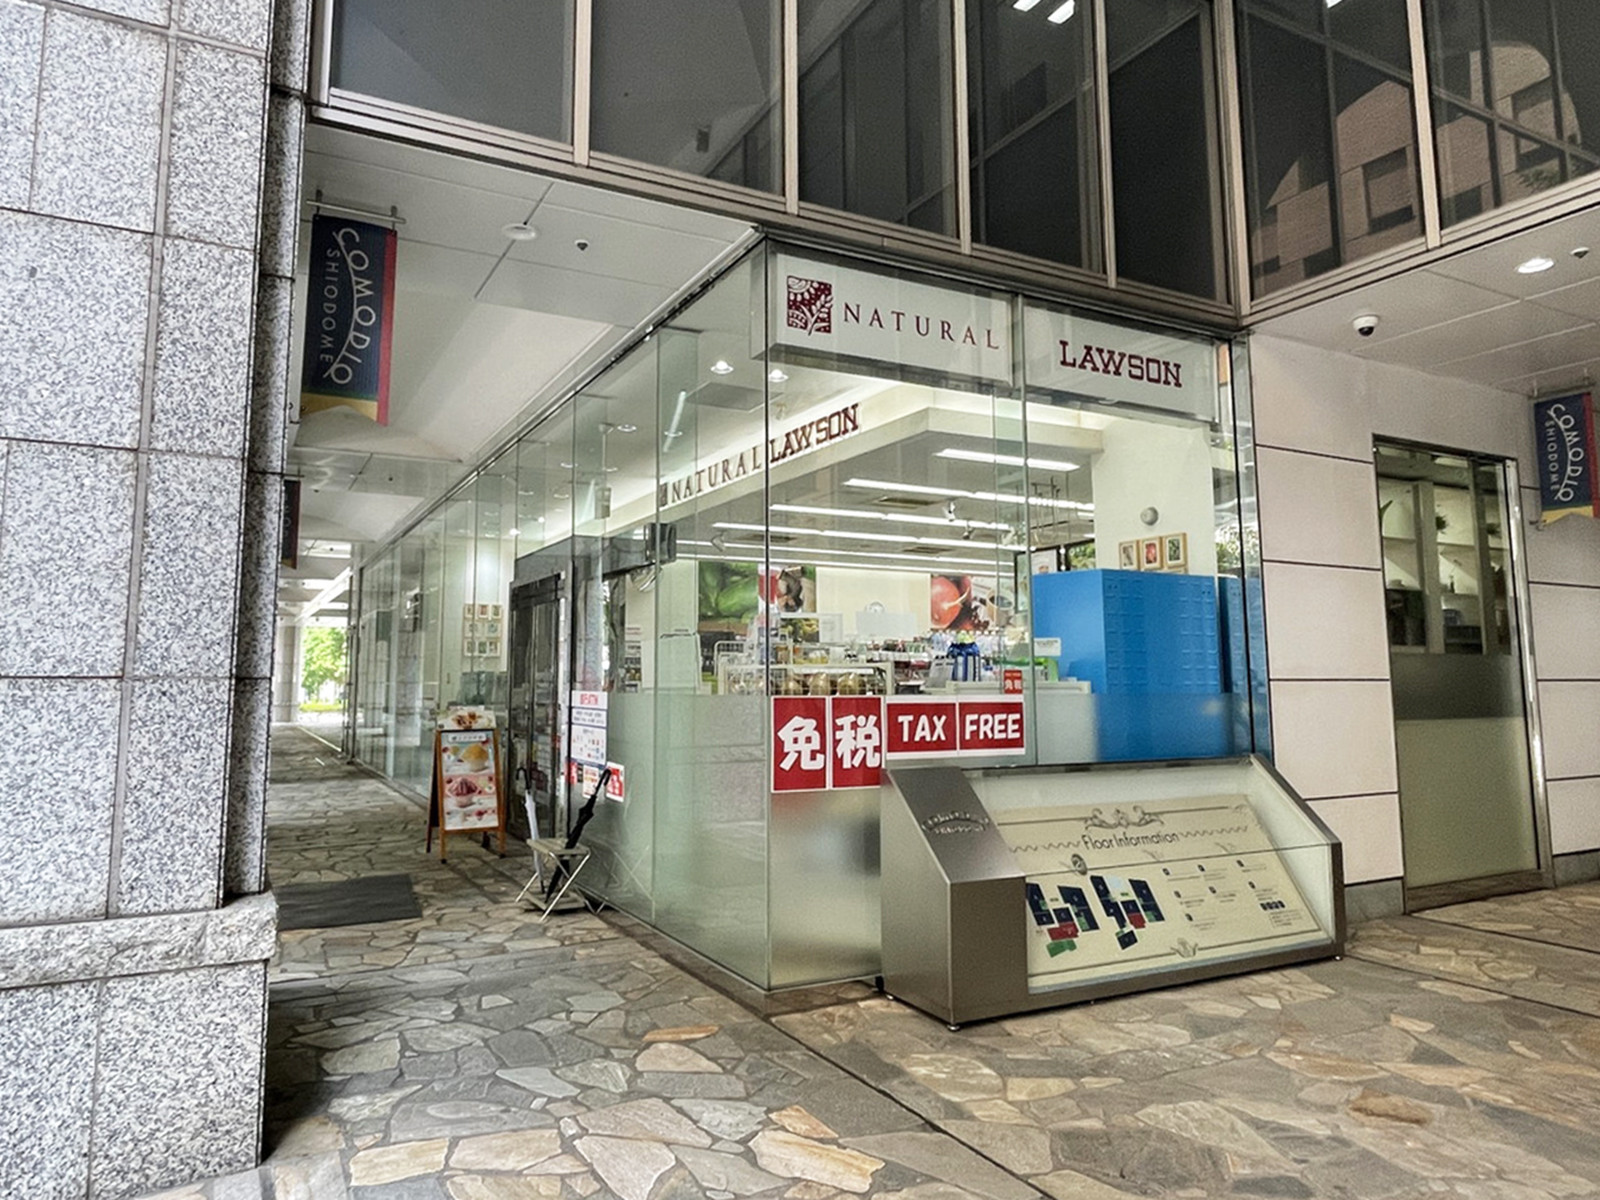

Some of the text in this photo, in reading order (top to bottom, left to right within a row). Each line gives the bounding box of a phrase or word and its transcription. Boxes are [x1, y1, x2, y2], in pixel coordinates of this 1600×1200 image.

[319, 247, 341, 364] SHIODOME
[323, 227, 376, 384] COMODIO
[842, 301, 1183, 389] NATURAL LAWSON
[671, 402, 860, 504] NATURAL LAWSON
[1544, 420, 1560, 490] SHIODOME
[1547, 403, 1585, 502] COMODIO
[777, 714, 881, 771] 免税
[897, 713, 1021, 743] TAX FREE
[1081, 831, 1180, 850] Floor Information
